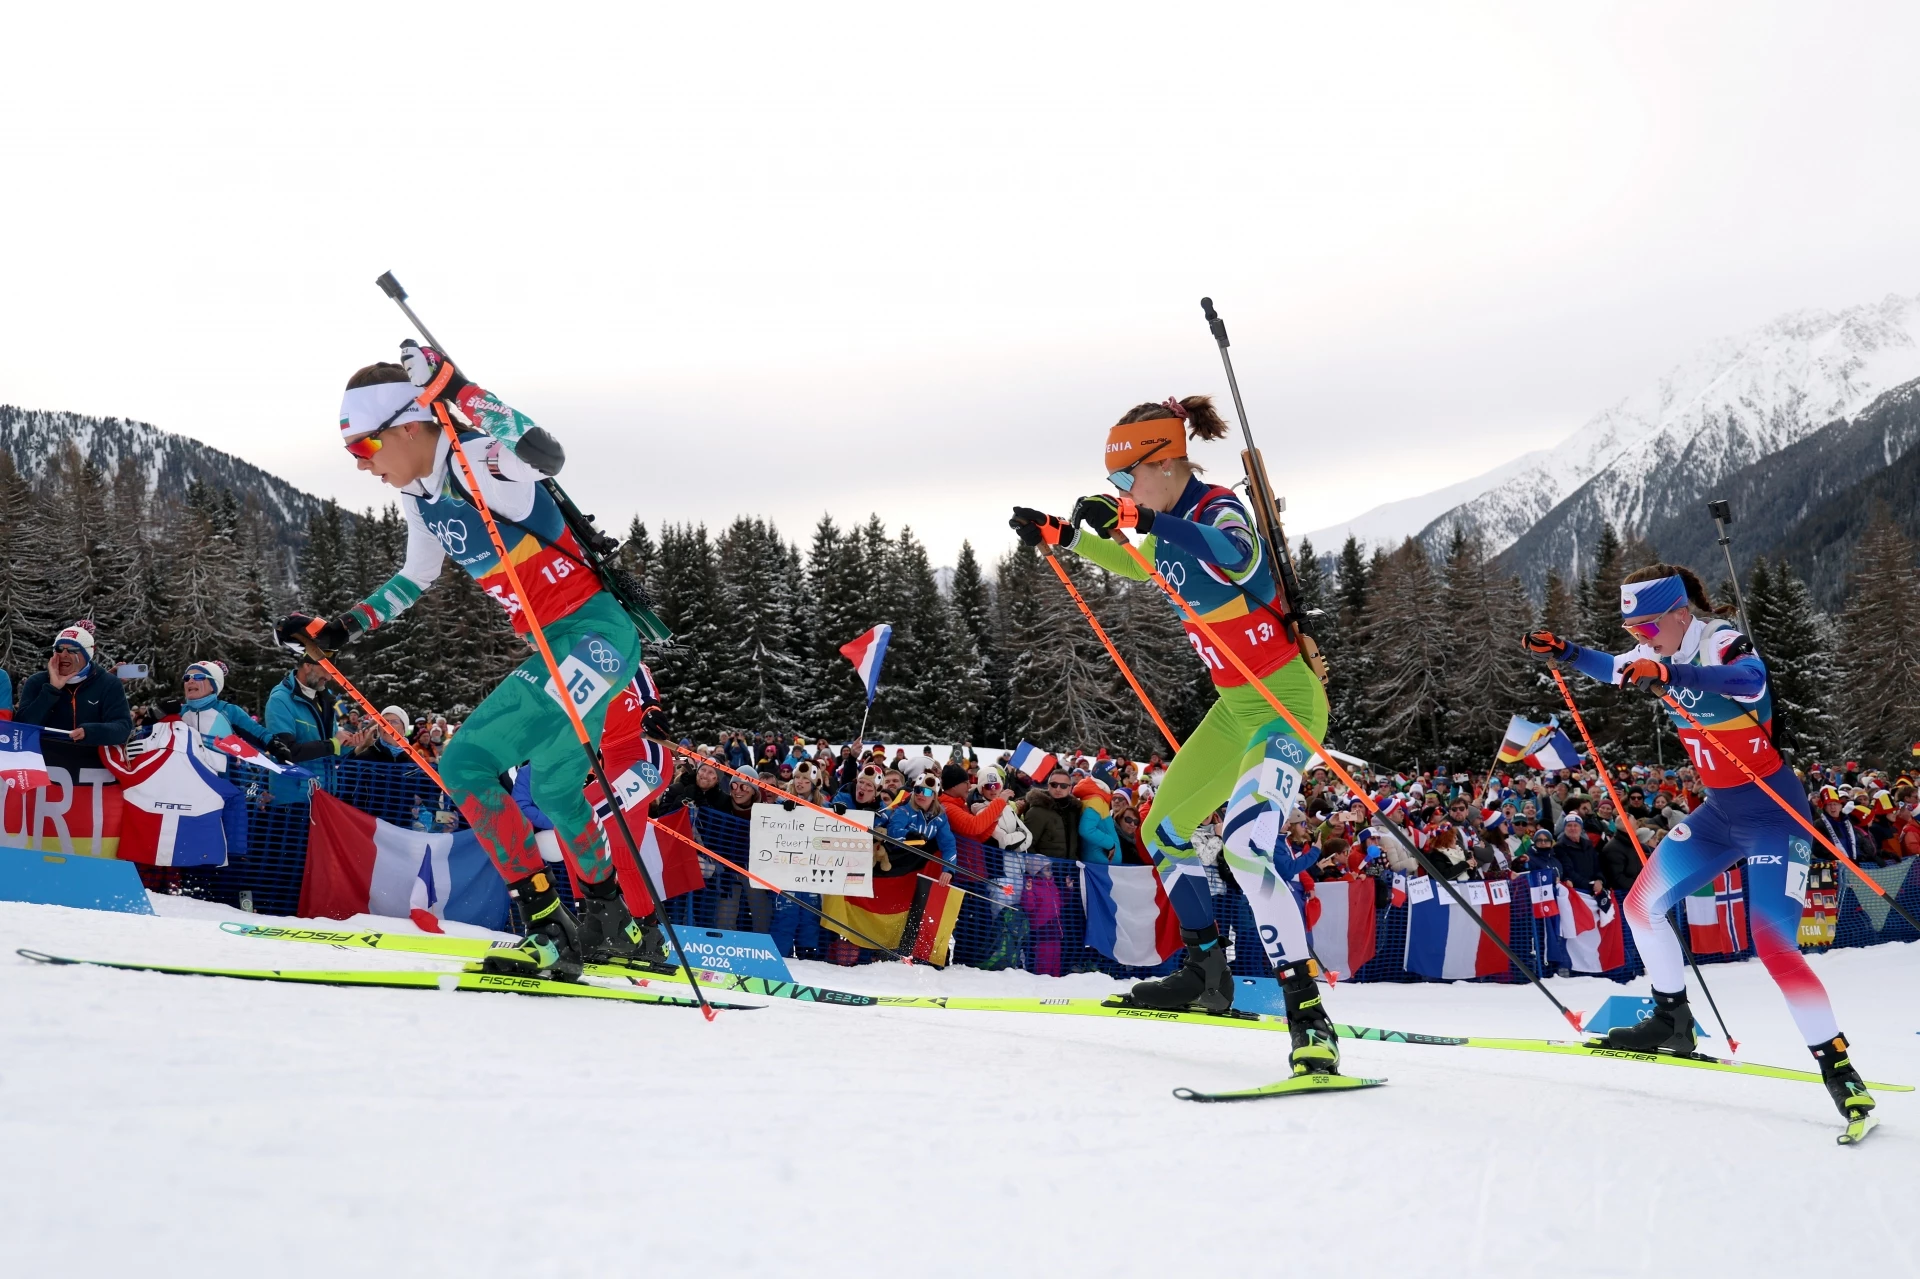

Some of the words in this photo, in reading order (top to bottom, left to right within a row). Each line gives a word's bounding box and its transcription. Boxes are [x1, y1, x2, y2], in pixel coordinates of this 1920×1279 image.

[566, 668, 596, 705] 15
[625, 781, 640, 798] 2
[1275, 767, 1294, 799] 13
[761, 815, 805, 832] Familie
[813, 816, 872, 833] Erdma
[775, 834, 812, 849] feuert
[1747, 854, 1783, 866] TEX
[795, 875, 808, 883] an
[1799, 870, 1806, 891] 7
[248, 926, 355, 942] FISCHER
[1801, 925, 1822, 936] TEAM
[715, 945, 777, 962] CORTINA
[701, 955, 730, 969] 2026
[479, 975, 541, 989] FISCHER
[1116, 1009, 1179, 1020] FISCHER
[1590, 1049, 1657, 1062] FISCHER
